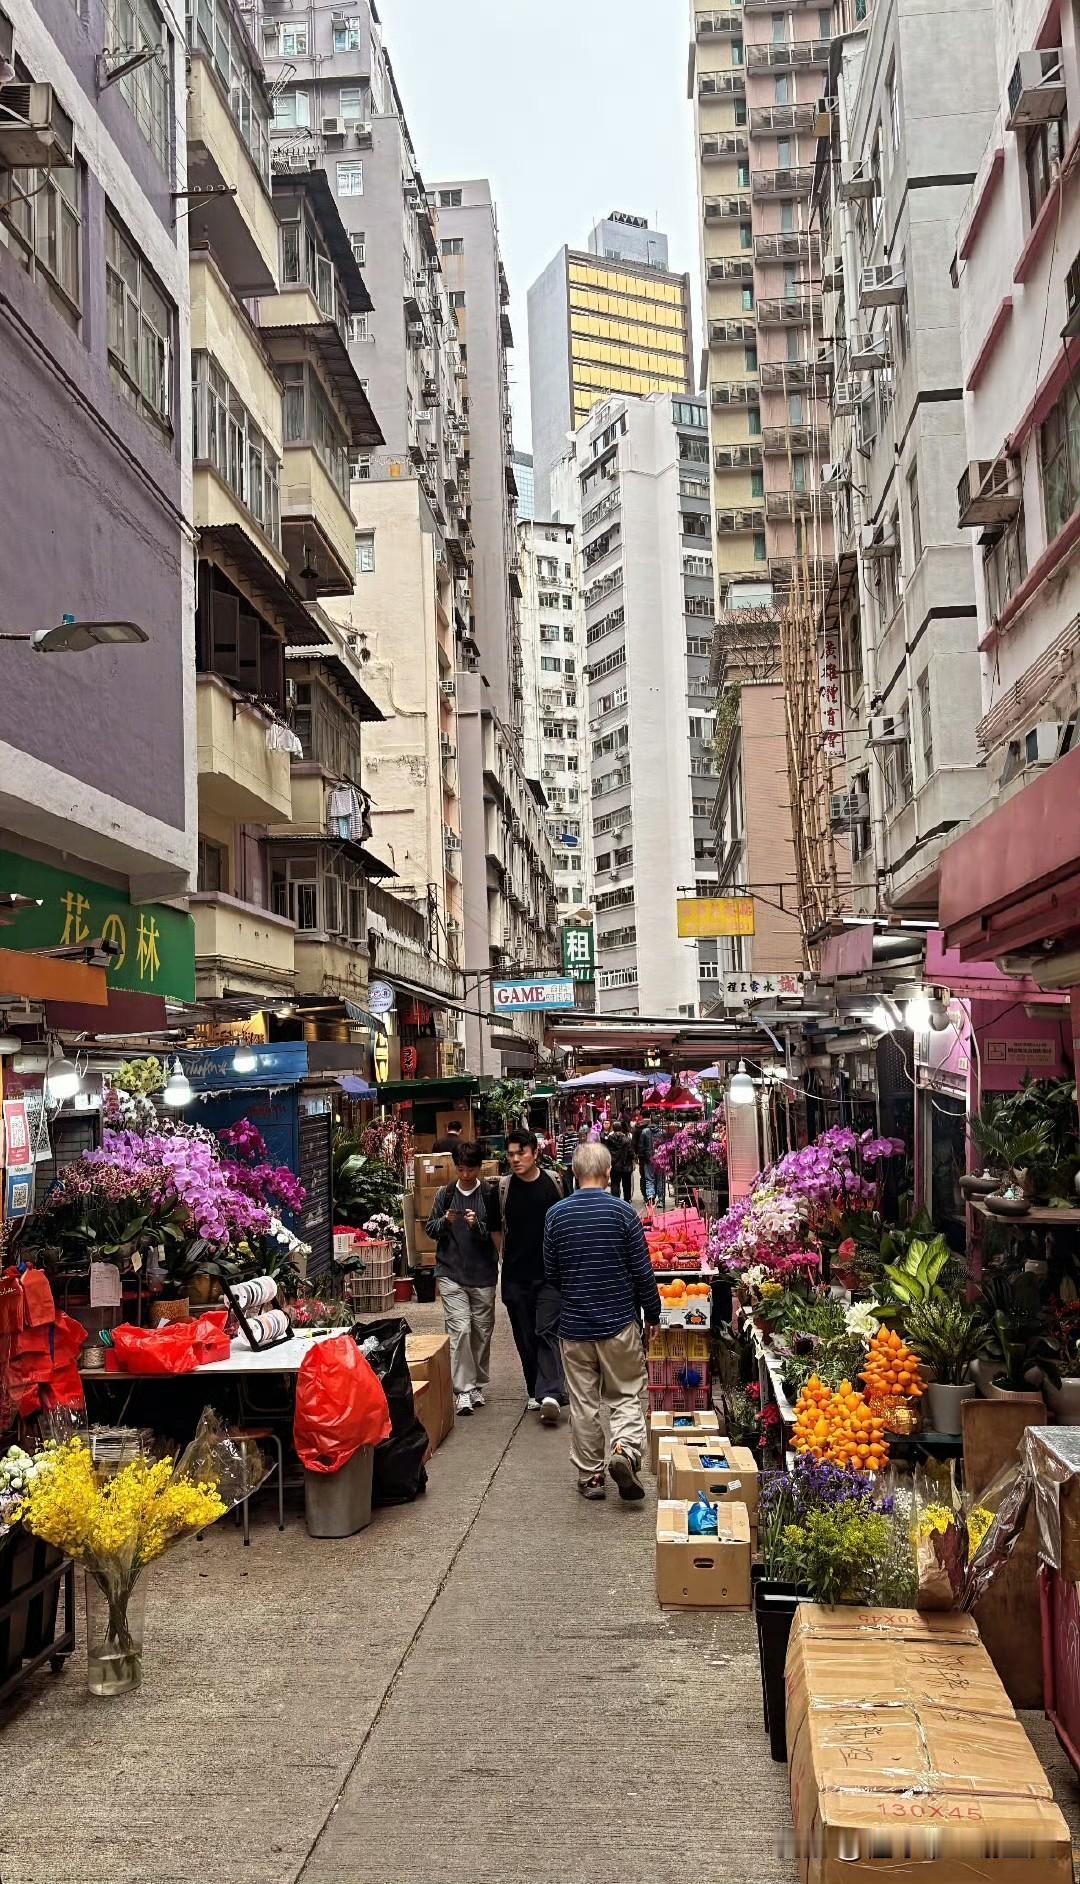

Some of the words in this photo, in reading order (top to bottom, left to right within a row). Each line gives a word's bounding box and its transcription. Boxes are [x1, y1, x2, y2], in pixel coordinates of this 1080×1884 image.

[60, 890, 160, 982] 花の林
[566, 930, 591, 962] 租
[727, 975, 804, 994] 誠水電工程
[497, 986, 546, 1004] GAME
[877, 1802, 983, 1822] 130X45
